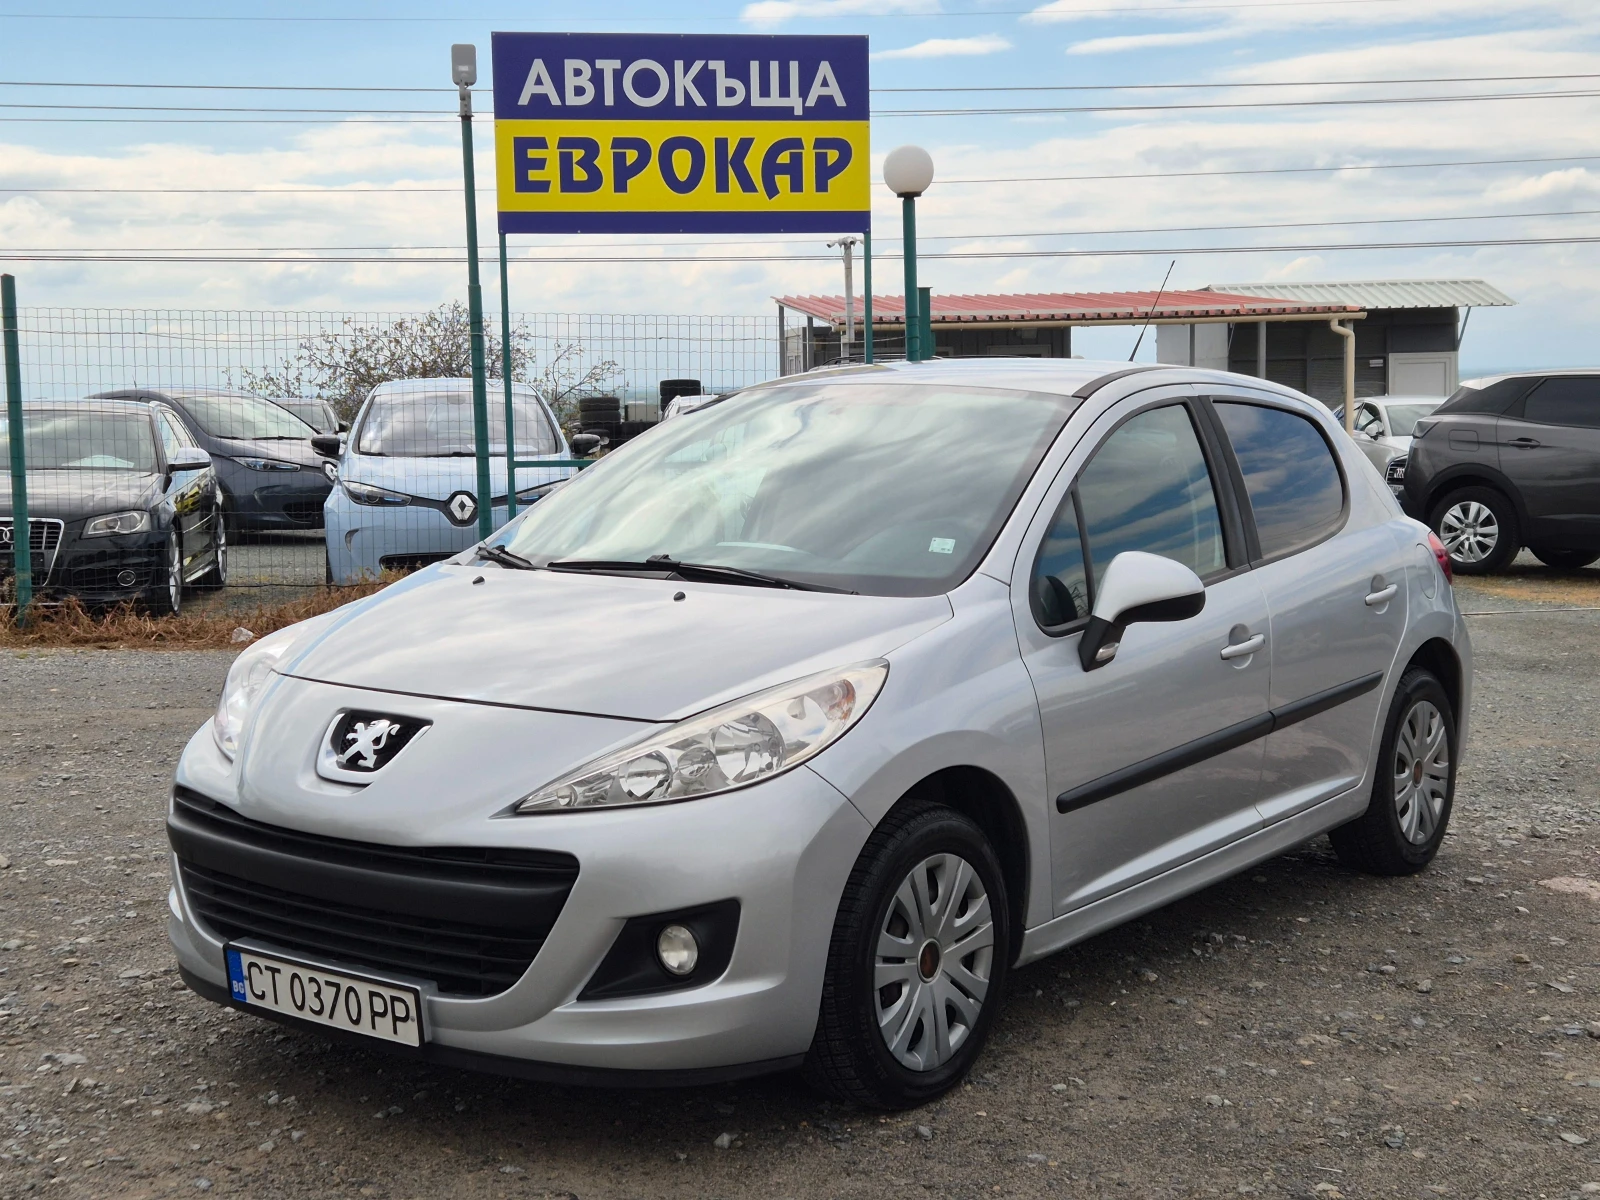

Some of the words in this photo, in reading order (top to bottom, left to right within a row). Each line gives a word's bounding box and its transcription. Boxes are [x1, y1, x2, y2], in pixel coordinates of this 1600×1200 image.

[517, 58, 847, 115] АВТОКЪЩА
[513, 136, 853, 201] ЕВРОКАР
[232, 980, 245, 994] BG
[247, 961, 281, 1005] CT
[290, 972, 362, 1026] 0370
[368, 990, 410, 1035] PP
